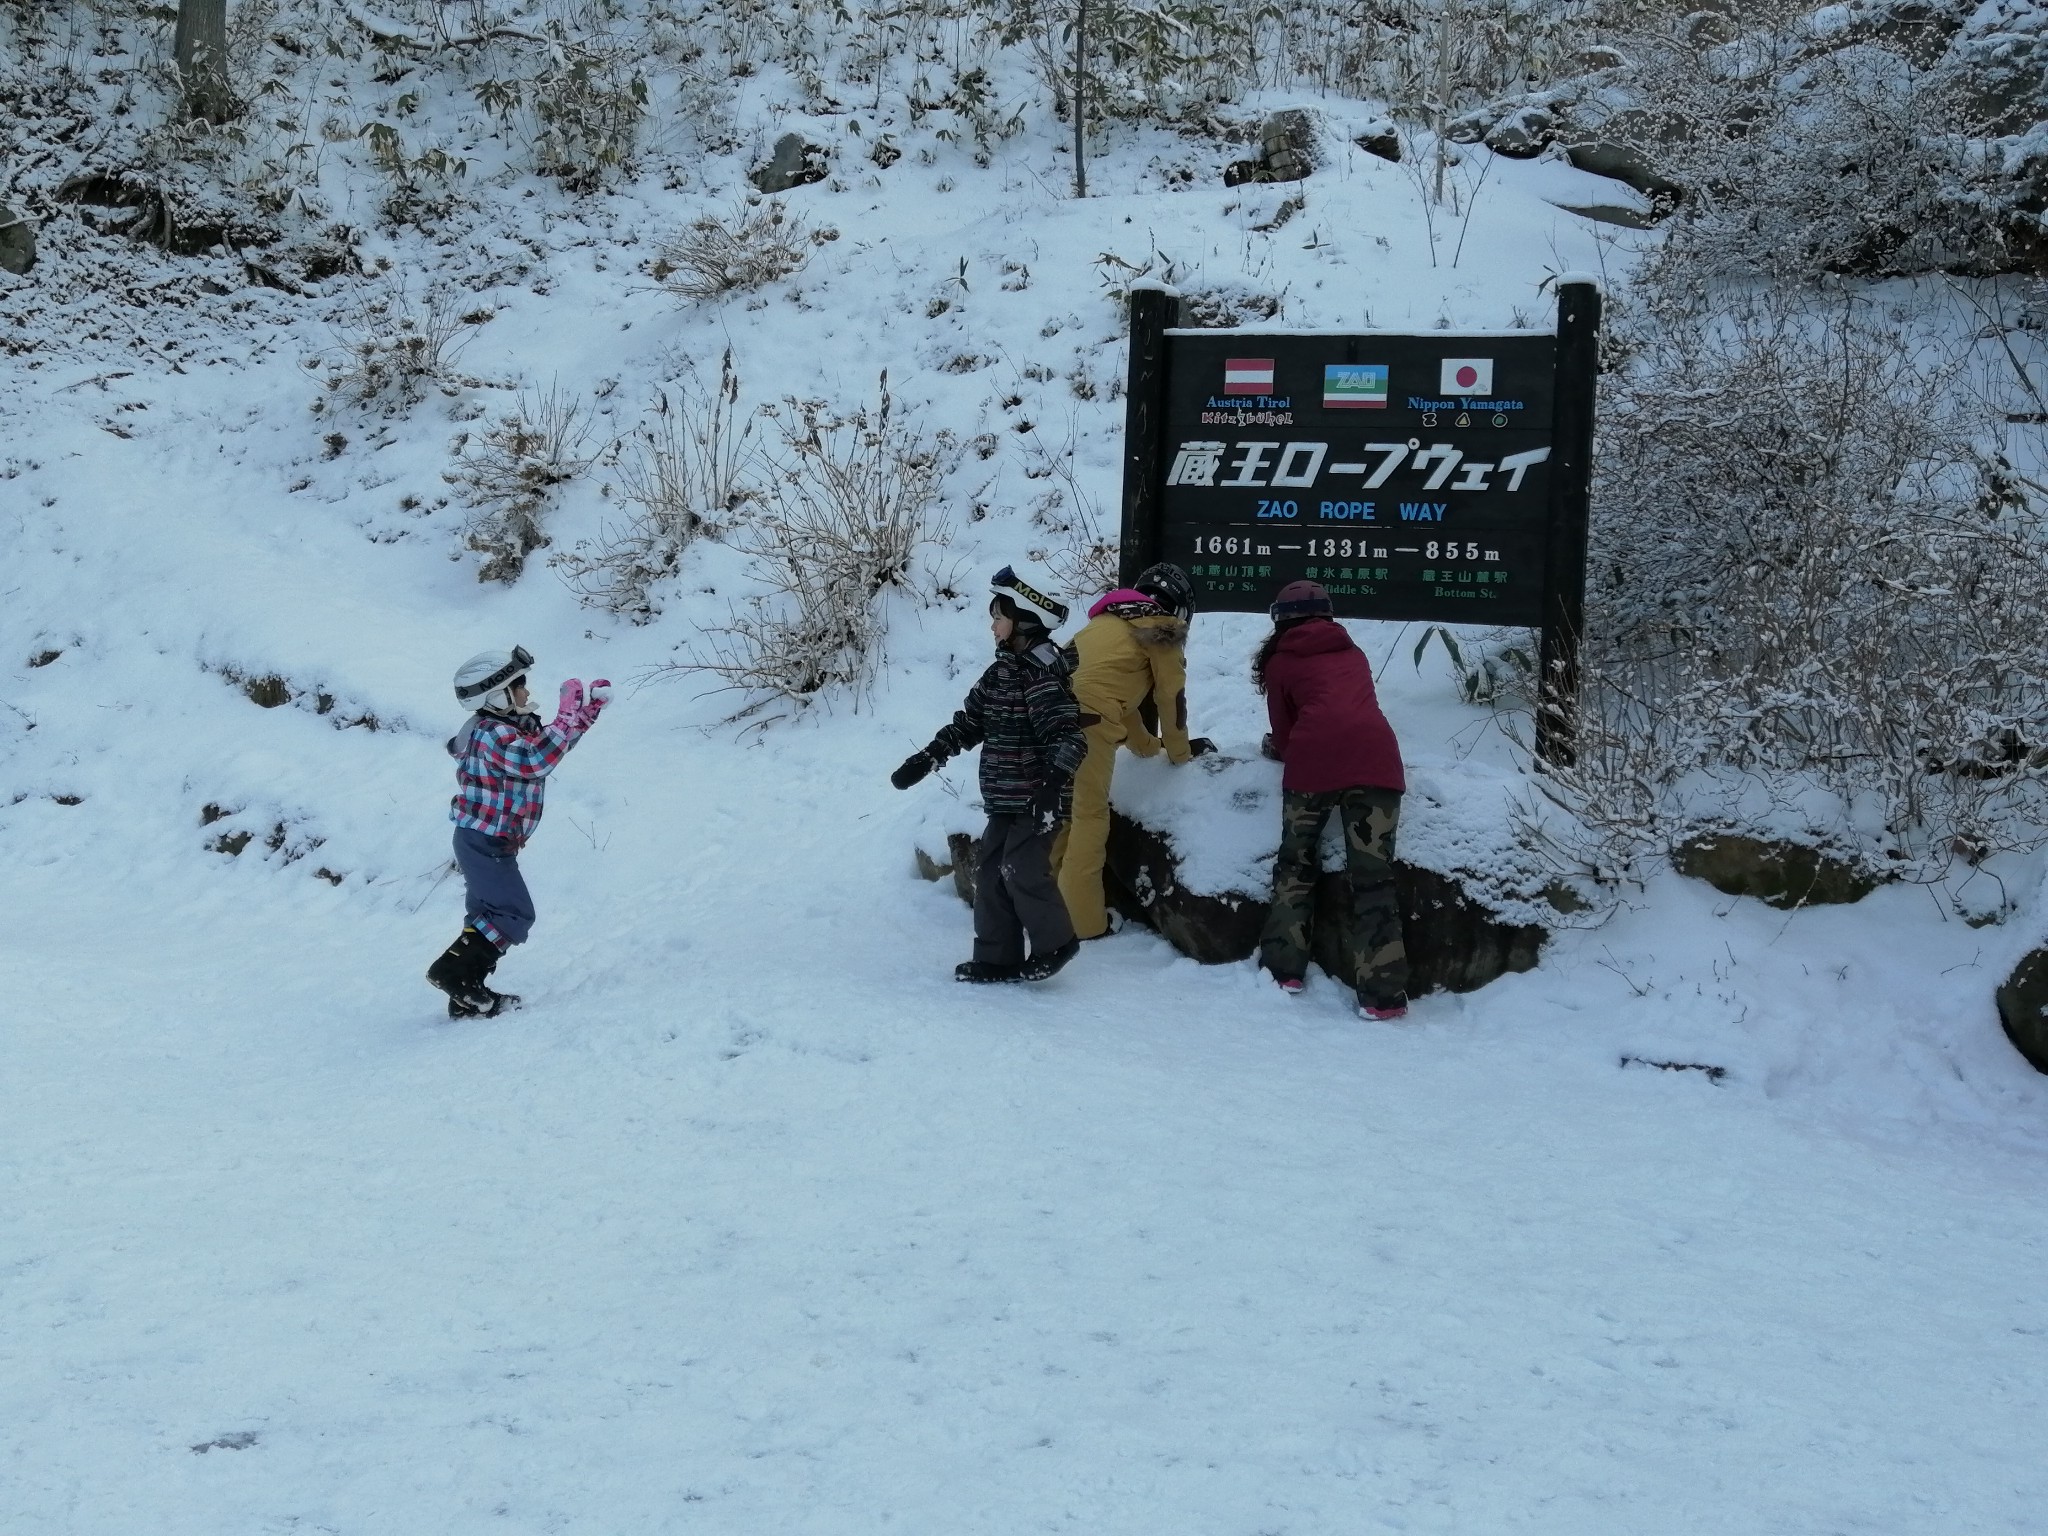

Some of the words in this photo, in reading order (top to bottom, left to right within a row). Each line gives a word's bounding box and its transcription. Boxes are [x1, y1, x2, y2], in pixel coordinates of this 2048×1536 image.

[1206, 395, 1253, 408] Austria
[1257, 396, 1291, 408] Tirol
[1408, 396, 1455, 412] Nippon
[1460, 397, 1524, 412] Yamagata
[1166, 437, 1552, 492] 蔵王ロープウェイ
[1257, 500, 1298, 519] ZAO
[1320, 501, 1376, 520] ROPE
[1400, 502, 1448, 522] WAY
[1434, 586, 1476, 598] Bottom
